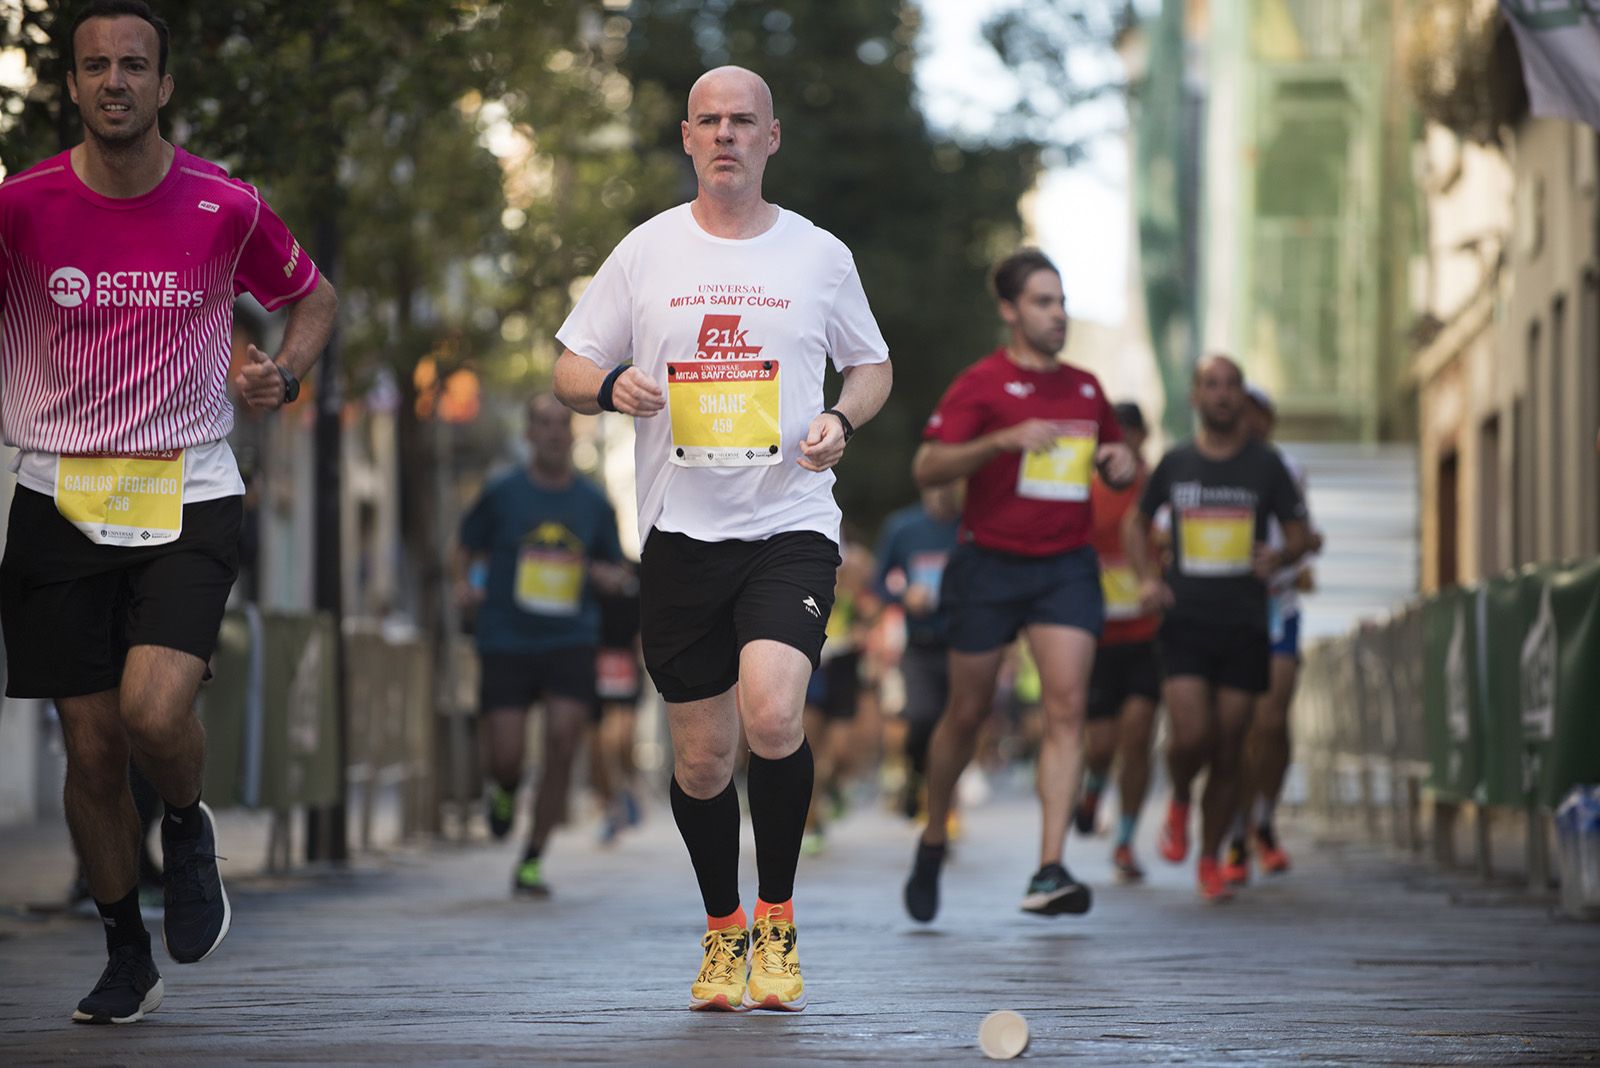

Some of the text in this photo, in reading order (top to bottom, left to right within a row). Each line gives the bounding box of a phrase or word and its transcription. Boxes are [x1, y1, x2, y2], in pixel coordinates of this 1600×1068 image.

[96, 271, 178, 289] ACTIVE
[698, 284, 765, 294] UNIVERSAE
[96, 289, 204, 308] RUNNERS
[670, 295, 791, 310] MITJA SANT CUGAT
[705, 328, 749, 347] 21K
[675, 369, 770, 380] MITJA SANT CUGAT 23
[699, 393, 747, 415] SHANE
[64, 474, 177, 495] CARLOS FEDERICO
